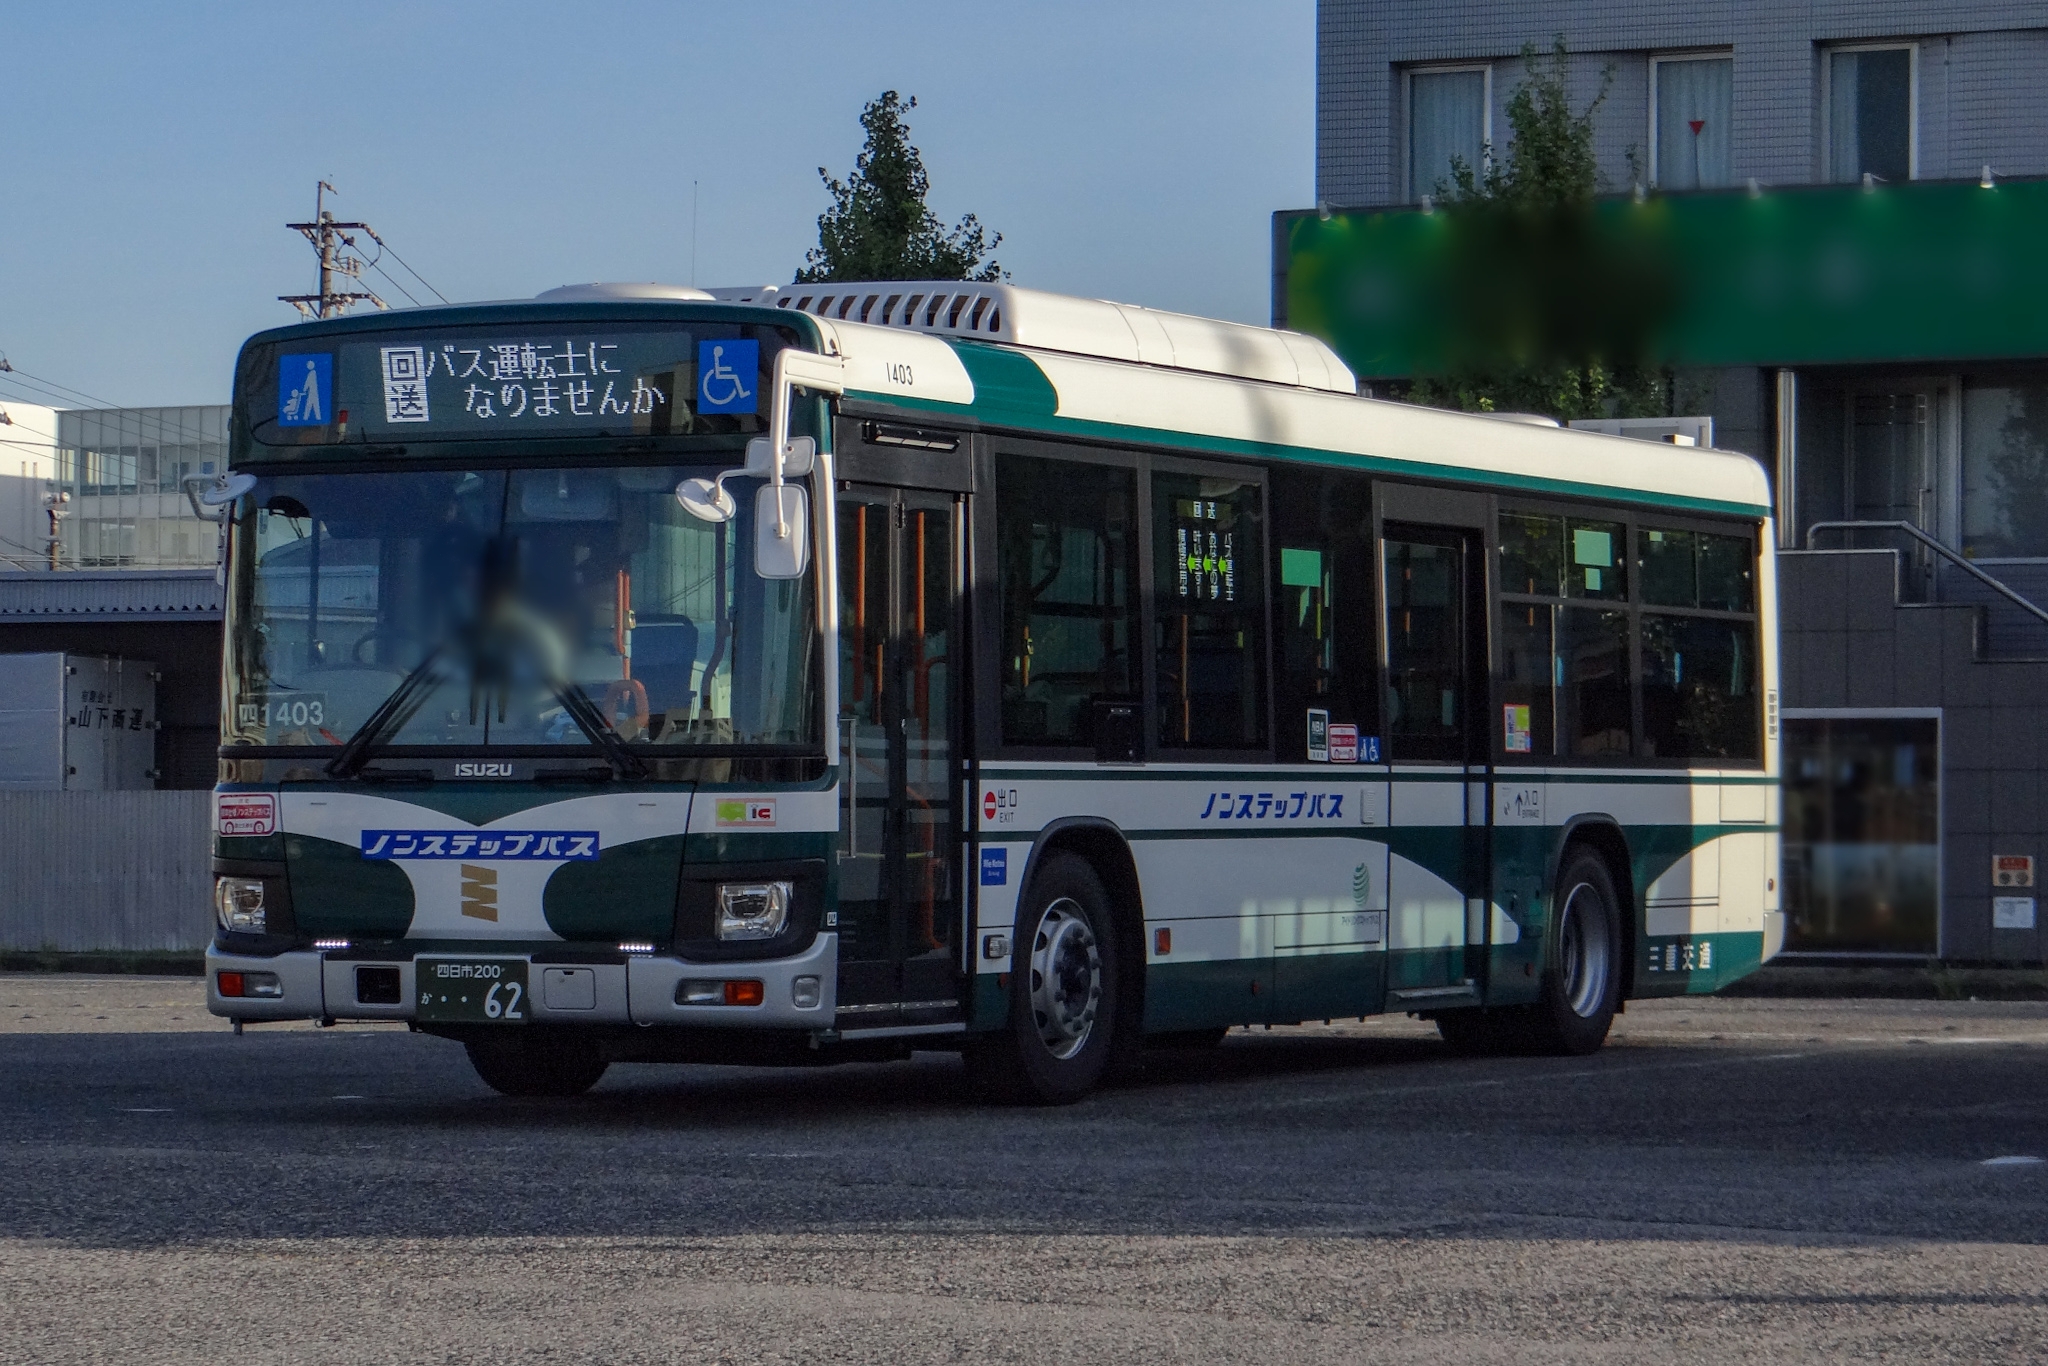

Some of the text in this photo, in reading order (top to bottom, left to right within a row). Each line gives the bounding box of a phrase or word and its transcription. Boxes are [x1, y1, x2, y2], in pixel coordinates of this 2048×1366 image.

[425, 341, 621, 380] バス運転士に
[383, 349, 427, 420] 回送
[886, 362, 913, 386] 1403
[464, 378, 665, 418] なりませんか
[455, 763, 512, 777] ISUZU
[998, 788, 1017, 808] 出口
[1200, 791, 1344, 819] ノンステップバス
[1524, 790, 1538, 805] 入口
[1000, 812, 1015, 823] EXIT
[365, 833, 596, 857] ノンステップバス
